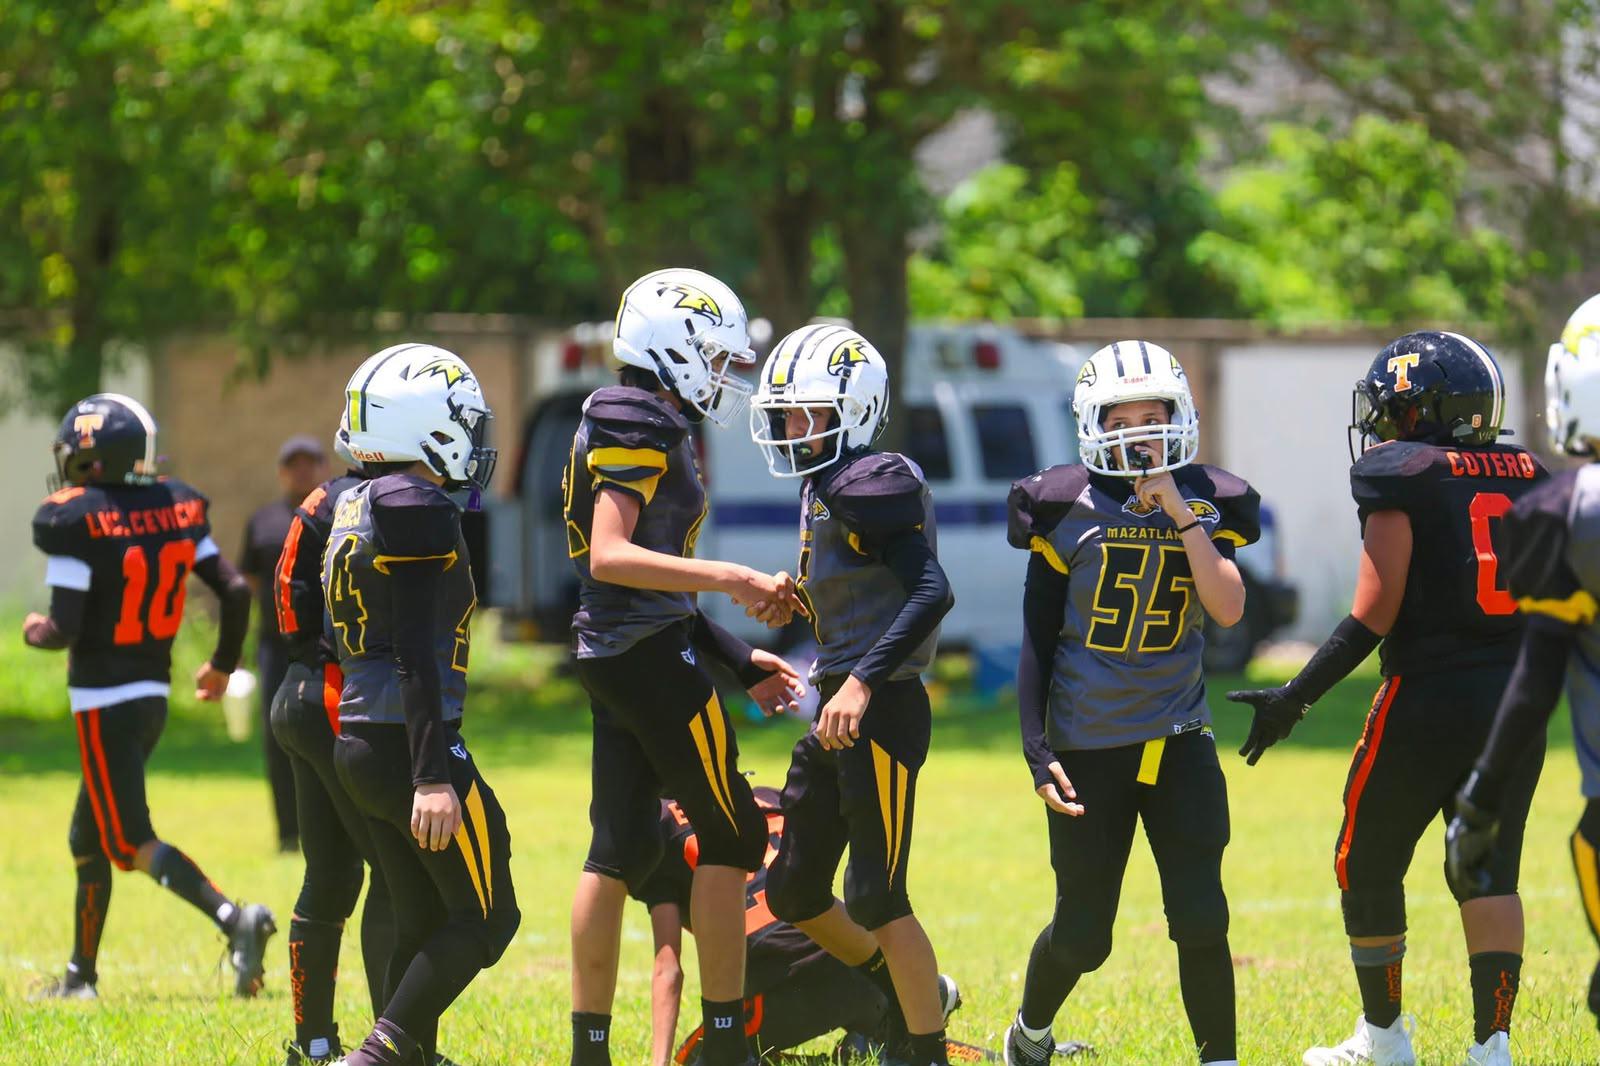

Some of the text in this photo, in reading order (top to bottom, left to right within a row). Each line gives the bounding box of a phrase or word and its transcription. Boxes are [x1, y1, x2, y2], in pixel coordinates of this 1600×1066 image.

[1386, 352, 1420, 393] T
[73, 413, 105, 449] T
[1445, 451, 1535, 479] COTERO
[113, 538, 197, 646] 10
[1085, 542, 1194, 654] 55
